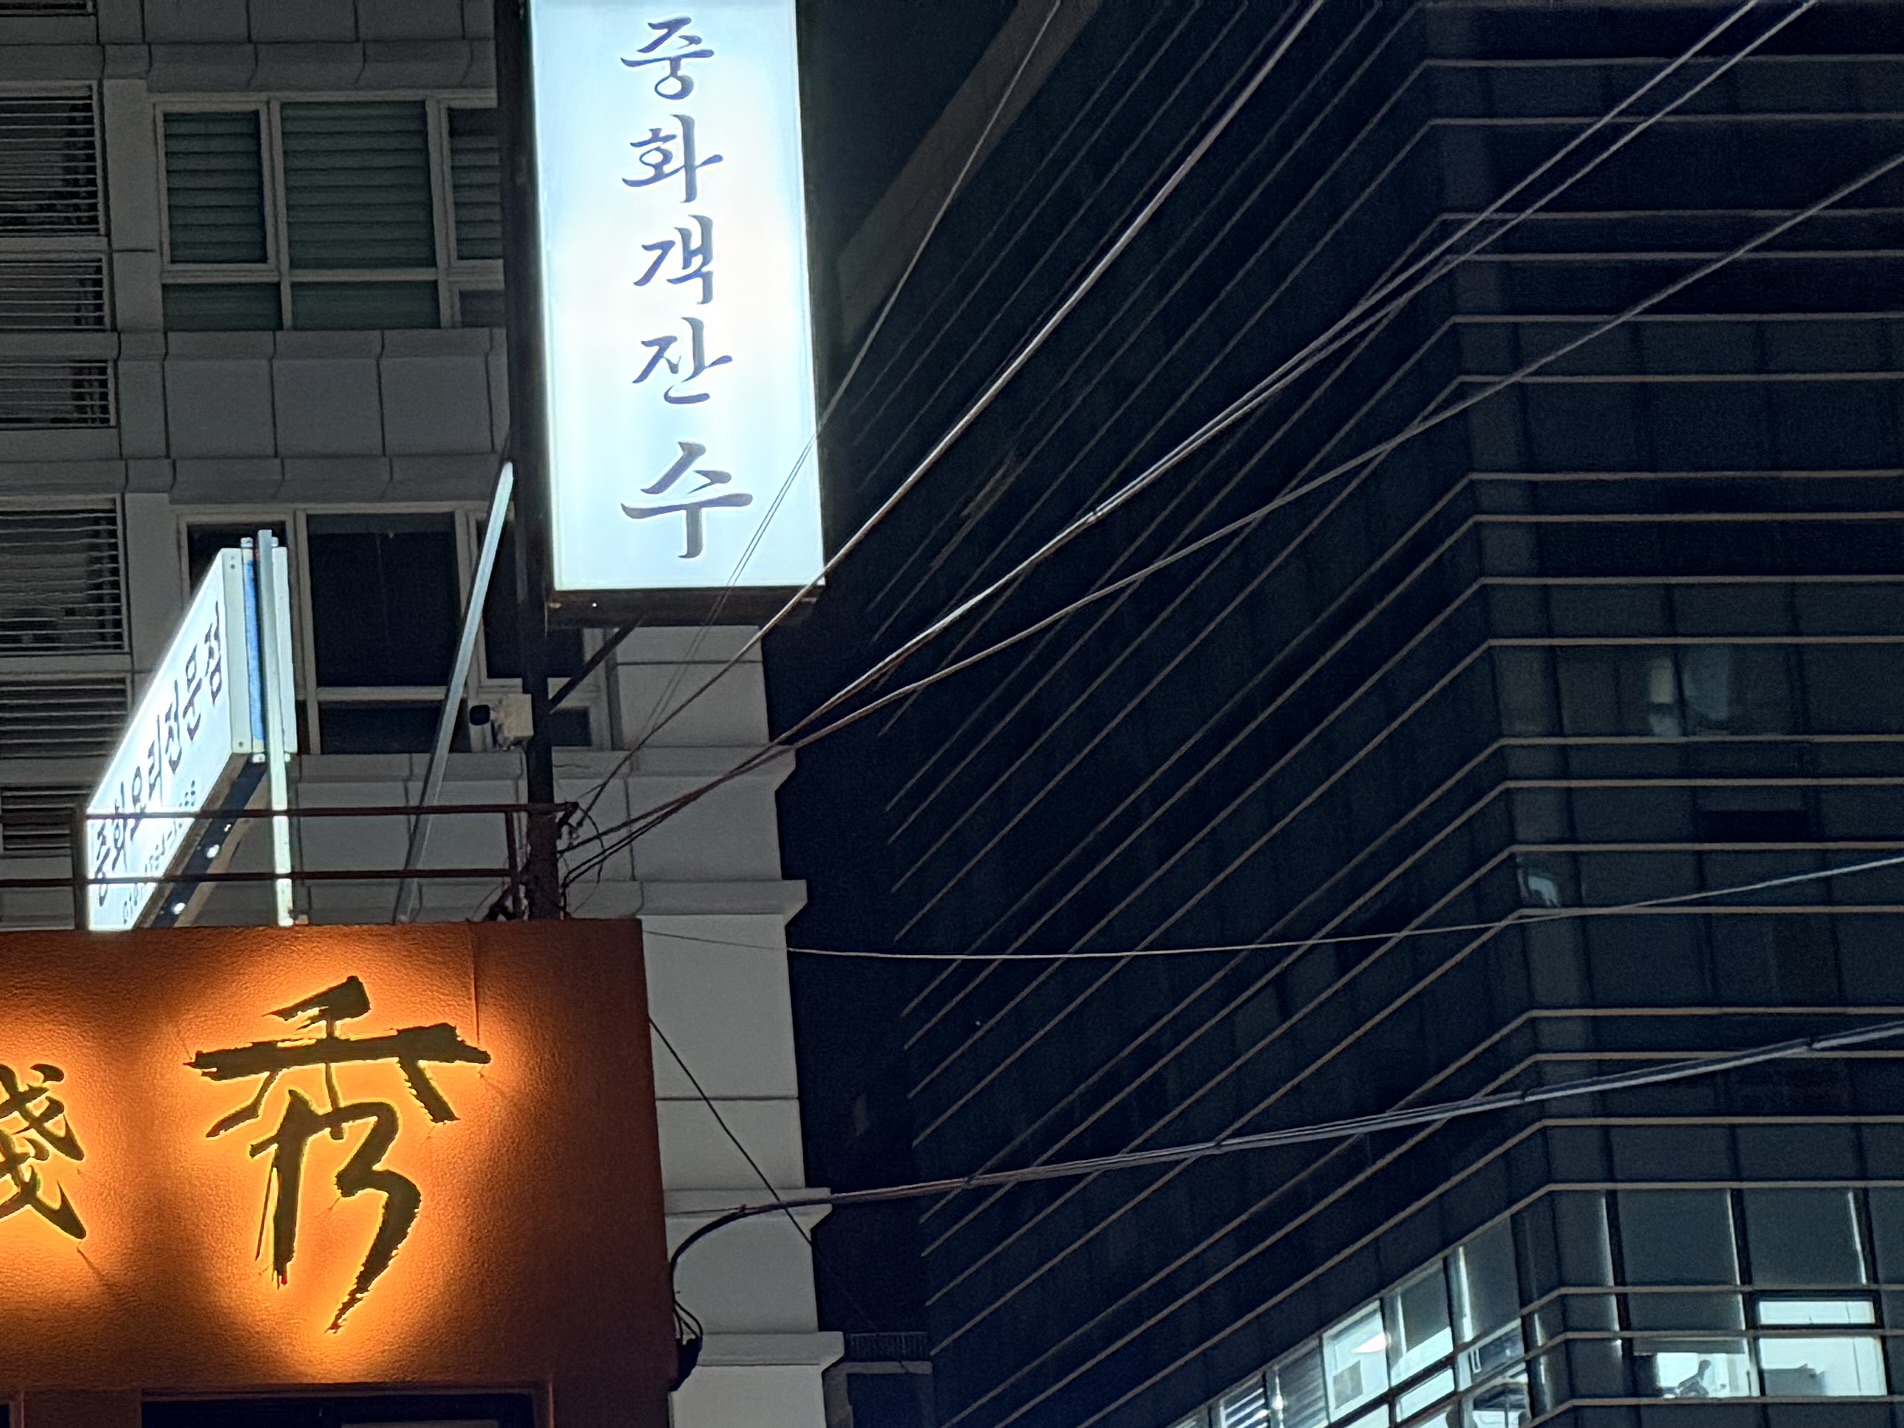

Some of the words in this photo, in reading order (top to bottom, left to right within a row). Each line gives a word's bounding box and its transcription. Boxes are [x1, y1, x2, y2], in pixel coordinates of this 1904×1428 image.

[620, 16, 734, 405] 중화객잔
[621, 441, 754, 560] 수
[184, 973, 492, 1334] 秀
